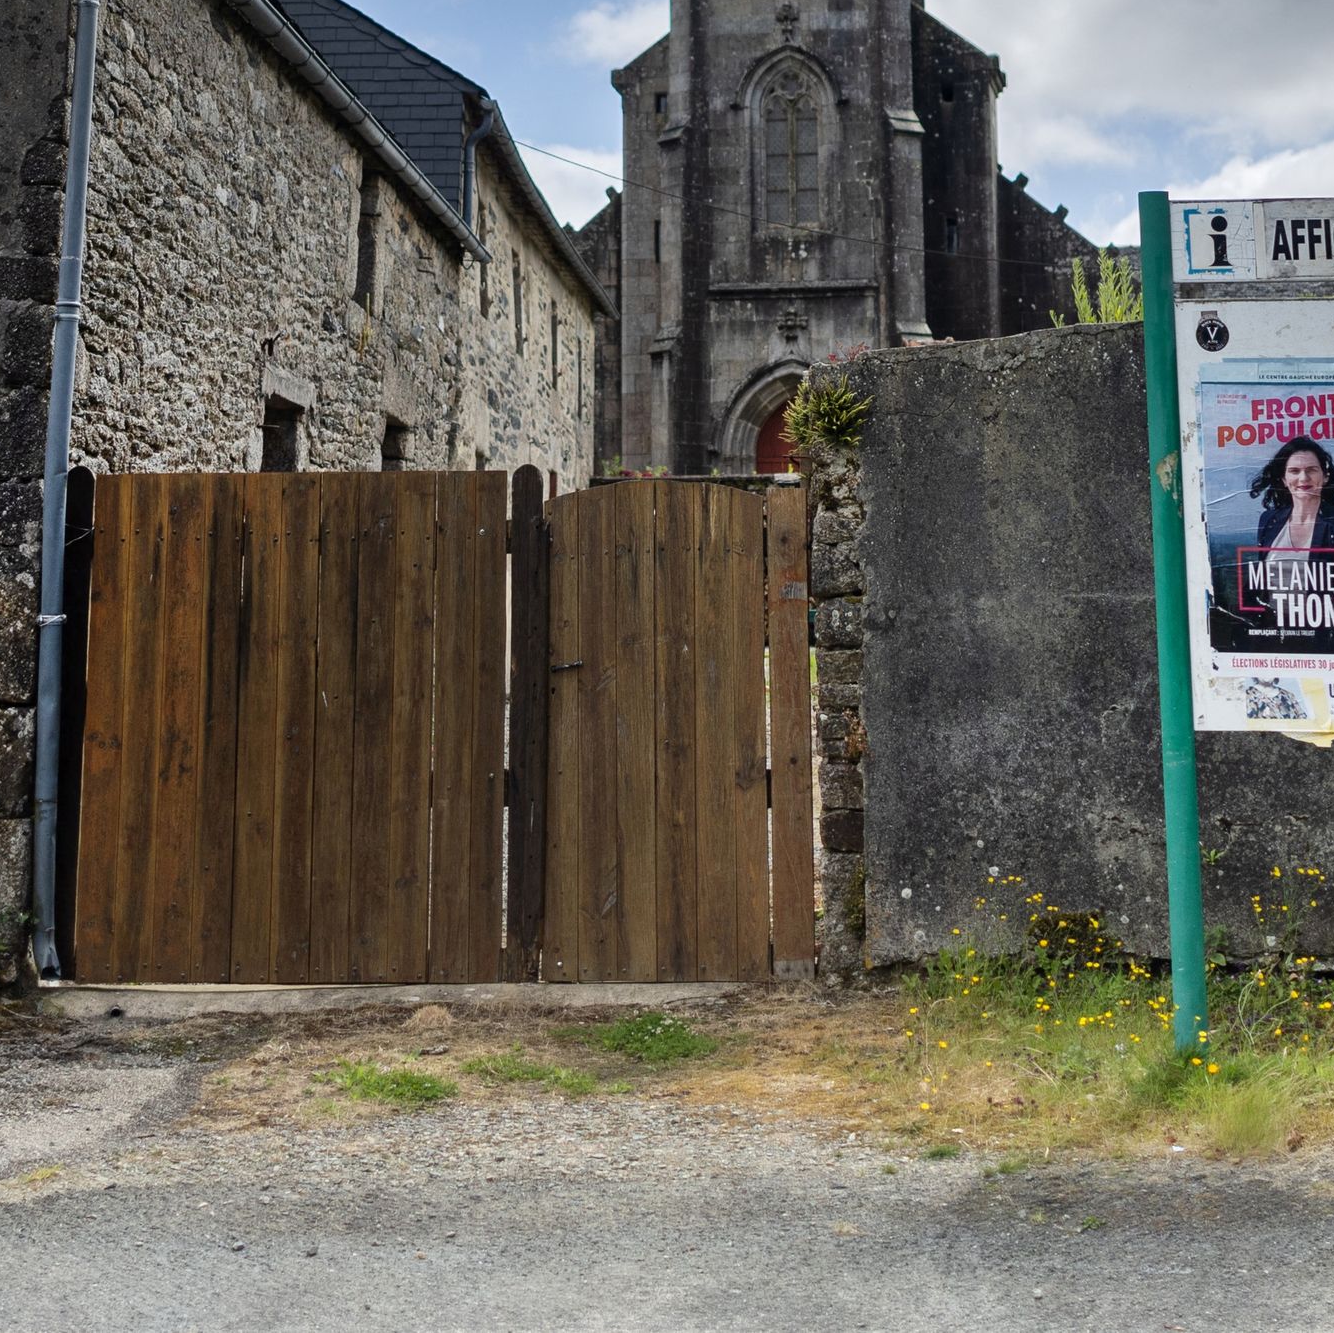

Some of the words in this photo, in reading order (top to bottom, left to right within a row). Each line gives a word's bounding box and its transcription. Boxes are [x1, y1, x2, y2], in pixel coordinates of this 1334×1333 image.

[1232, 656, 1268, 668] ÉLECTIONS
[1270, 657, 1316, 669] LÉGISLATIVES
[1318, 660, 1327, 669] 30
